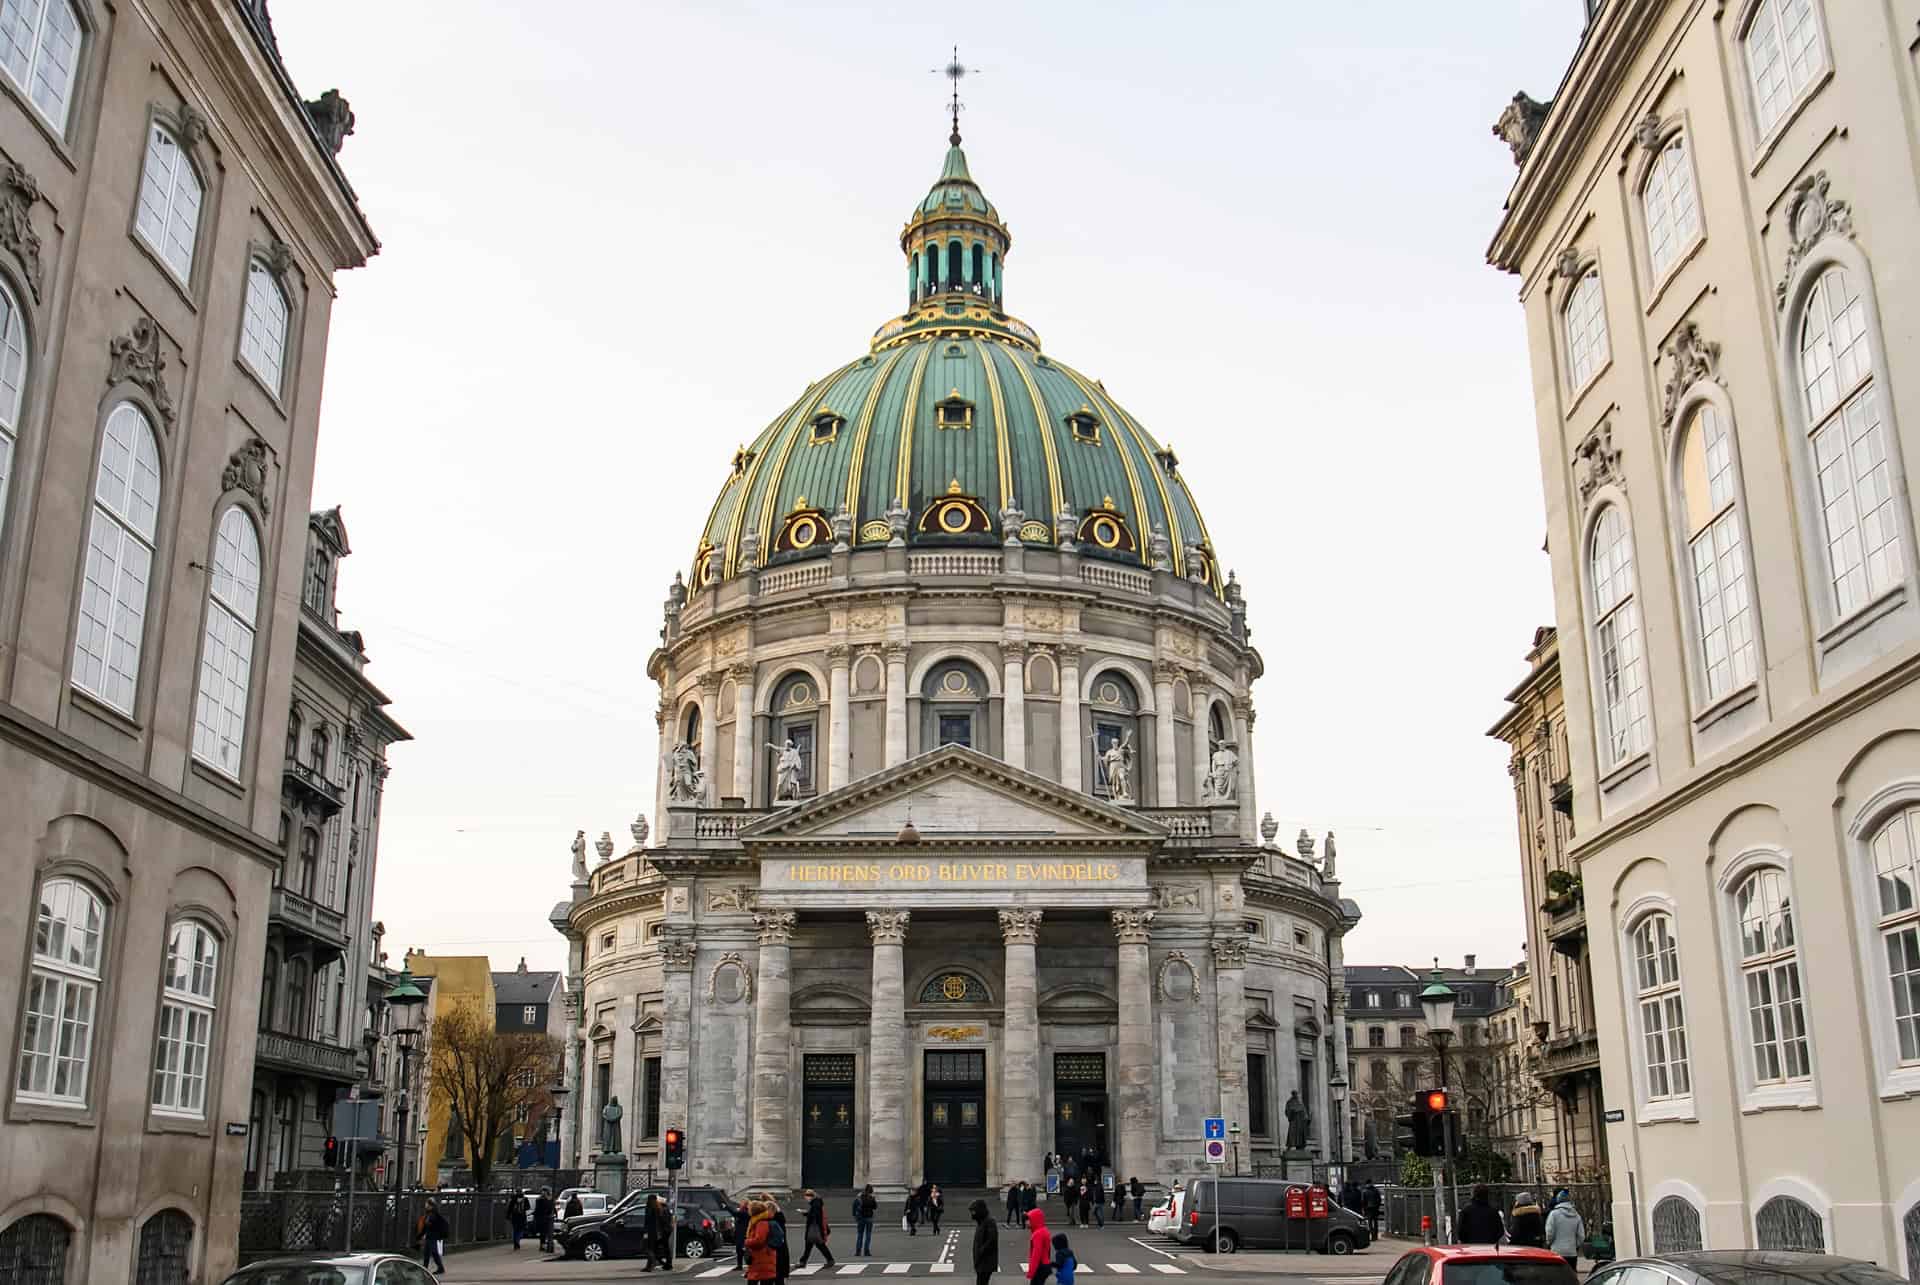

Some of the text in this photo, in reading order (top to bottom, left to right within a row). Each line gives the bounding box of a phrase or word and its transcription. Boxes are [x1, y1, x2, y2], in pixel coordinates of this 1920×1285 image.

[790, 864, 880, 881] HERRENS
[889, 863, 930, 881] ORD
[938, 863, 1008, 881] BLIVER
